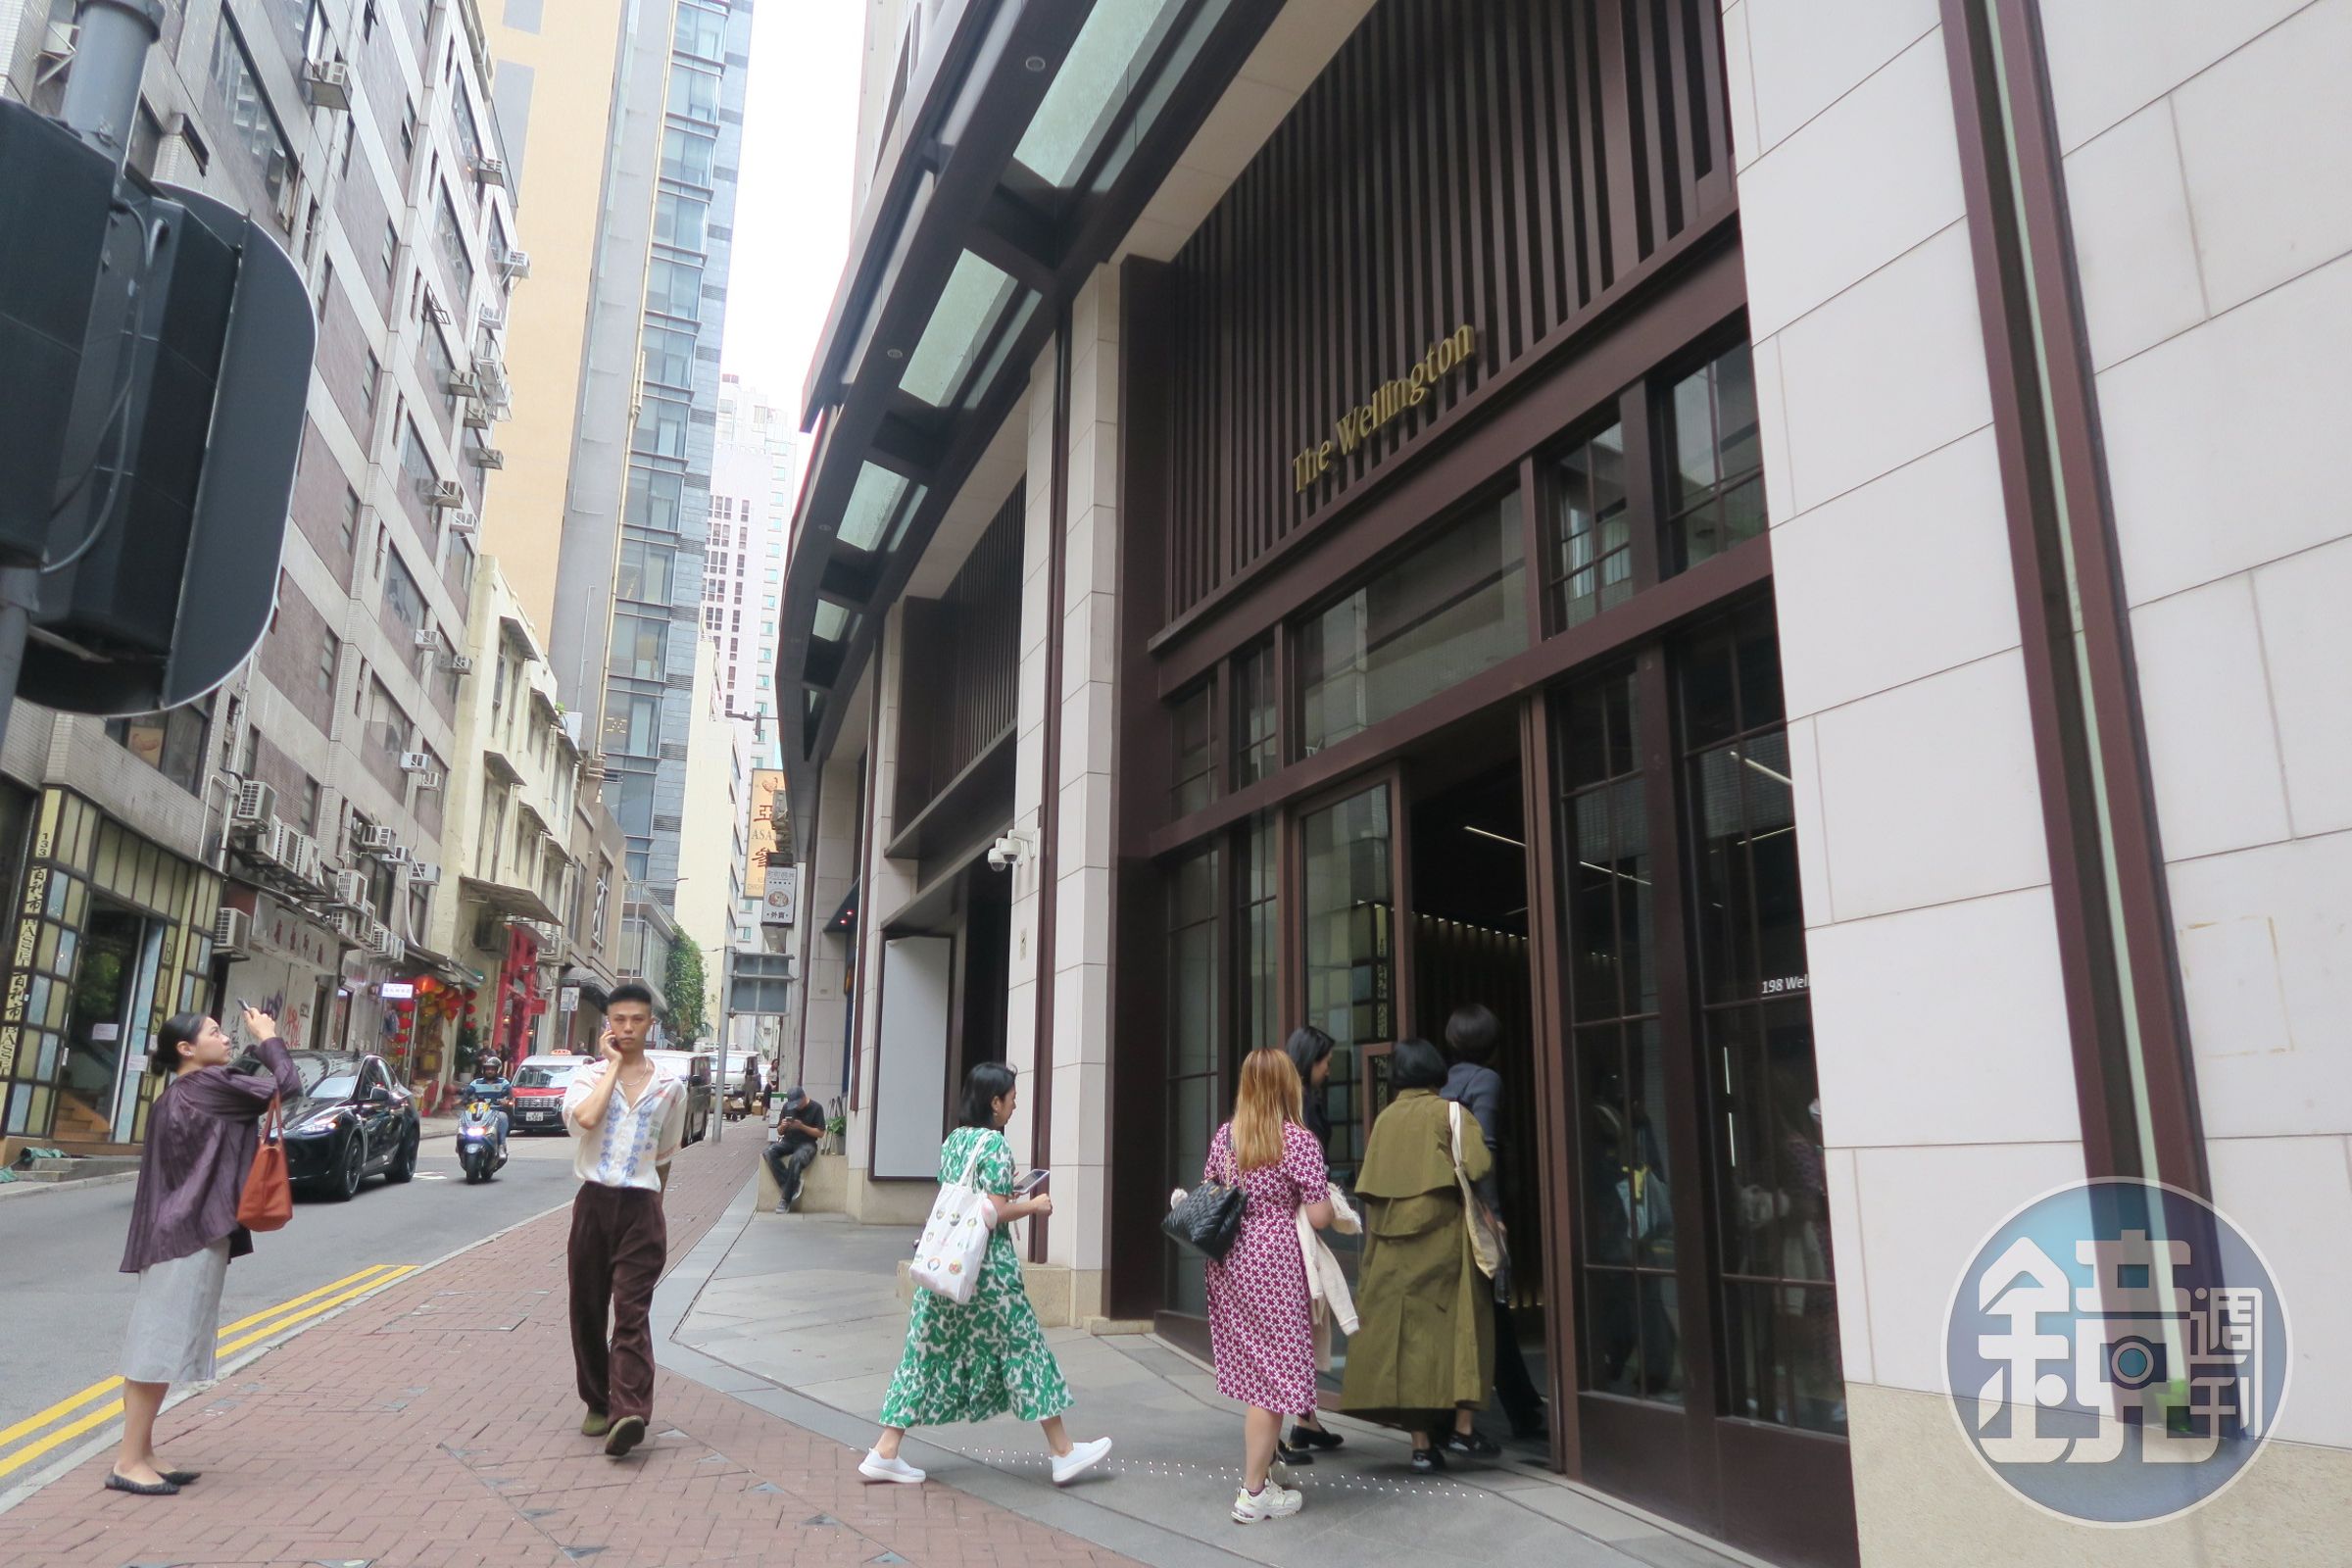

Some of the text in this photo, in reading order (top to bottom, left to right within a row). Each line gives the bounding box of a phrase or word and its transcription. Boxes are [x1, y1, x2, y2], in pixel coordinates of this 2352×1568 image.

[1293, 323, 1475, 494] The Wellington
[38, 832, 48, 857] 133
[752, 828, 775, 841] ASA
[1761, 978, 1784, 994] 198
